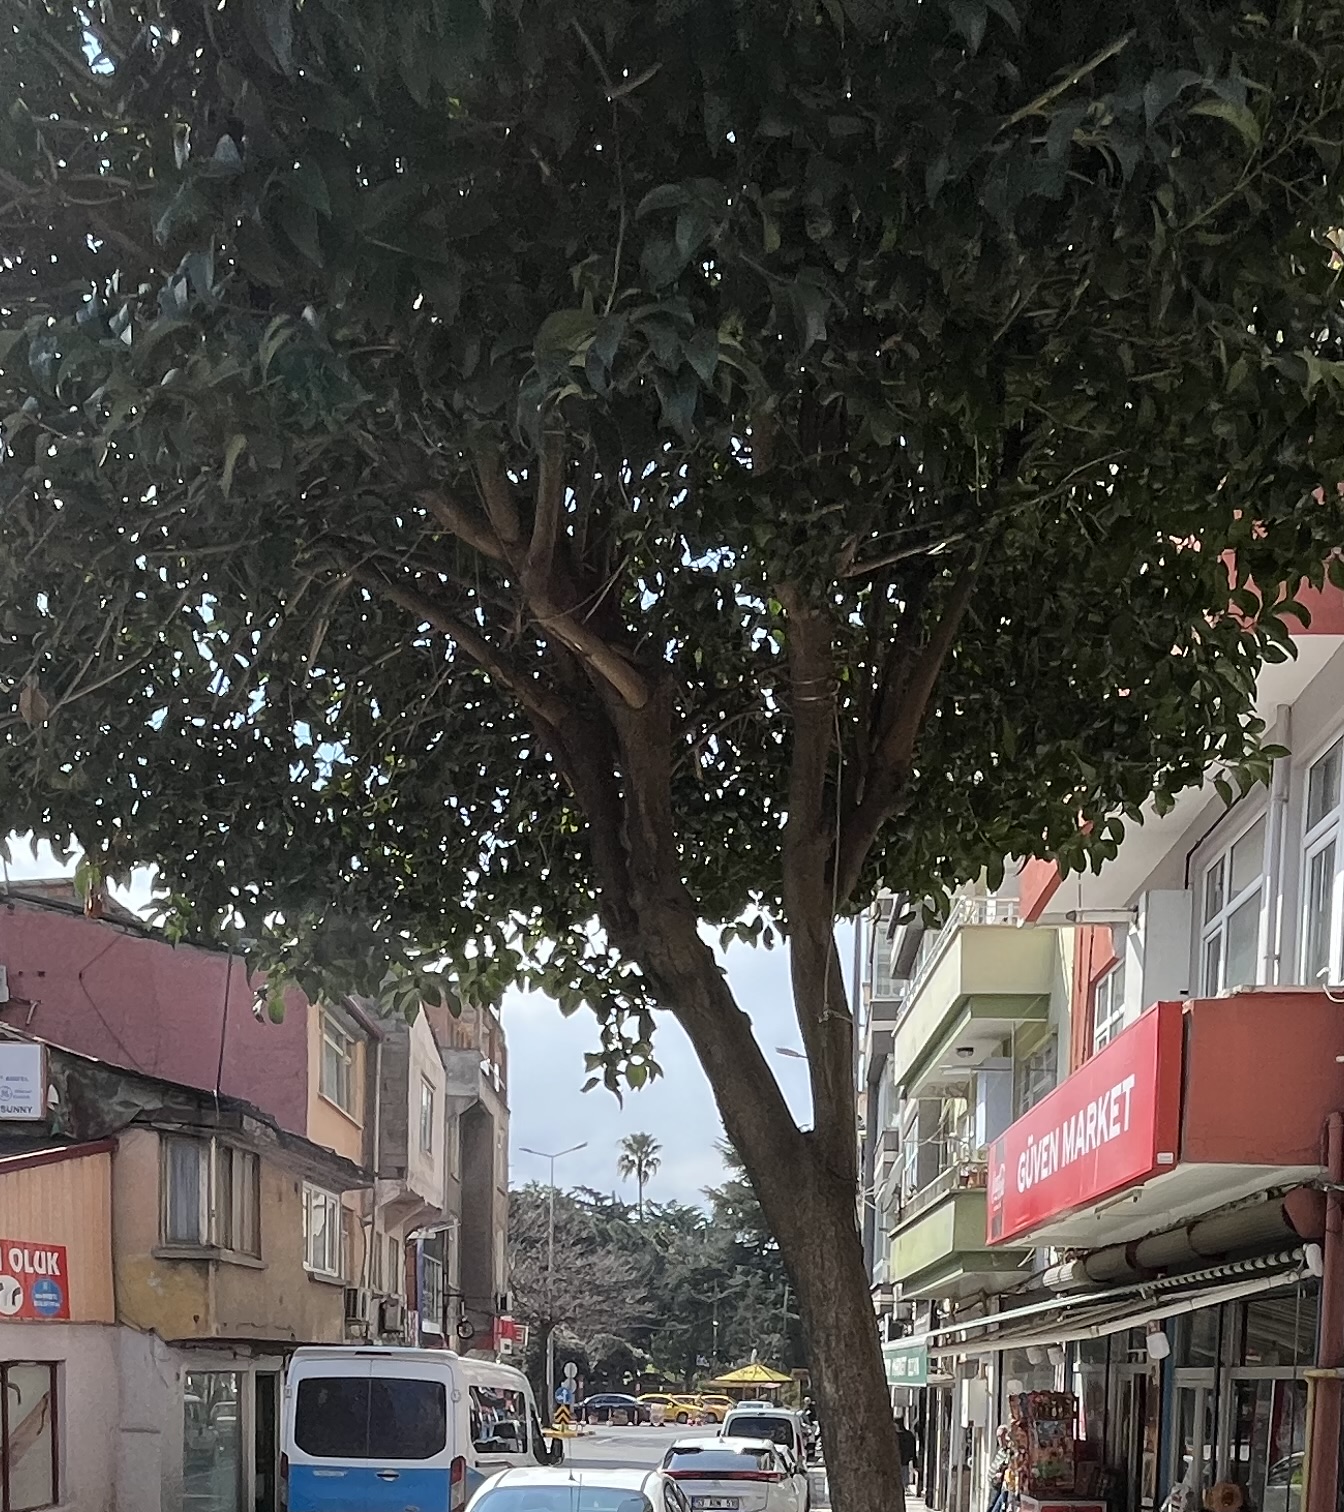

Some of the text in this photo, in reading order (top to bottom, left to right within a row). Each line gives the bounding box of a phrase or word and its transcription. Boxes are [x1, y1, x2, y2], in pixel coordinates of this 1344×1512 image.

[0, 1105, 33, 1113] SUNNY
[1017, 1127, 1060, 1194] GÜVEN
[1061, 1073, 1136, 1169] MARKET
[8, 1247, 61, 1276] OLUK
